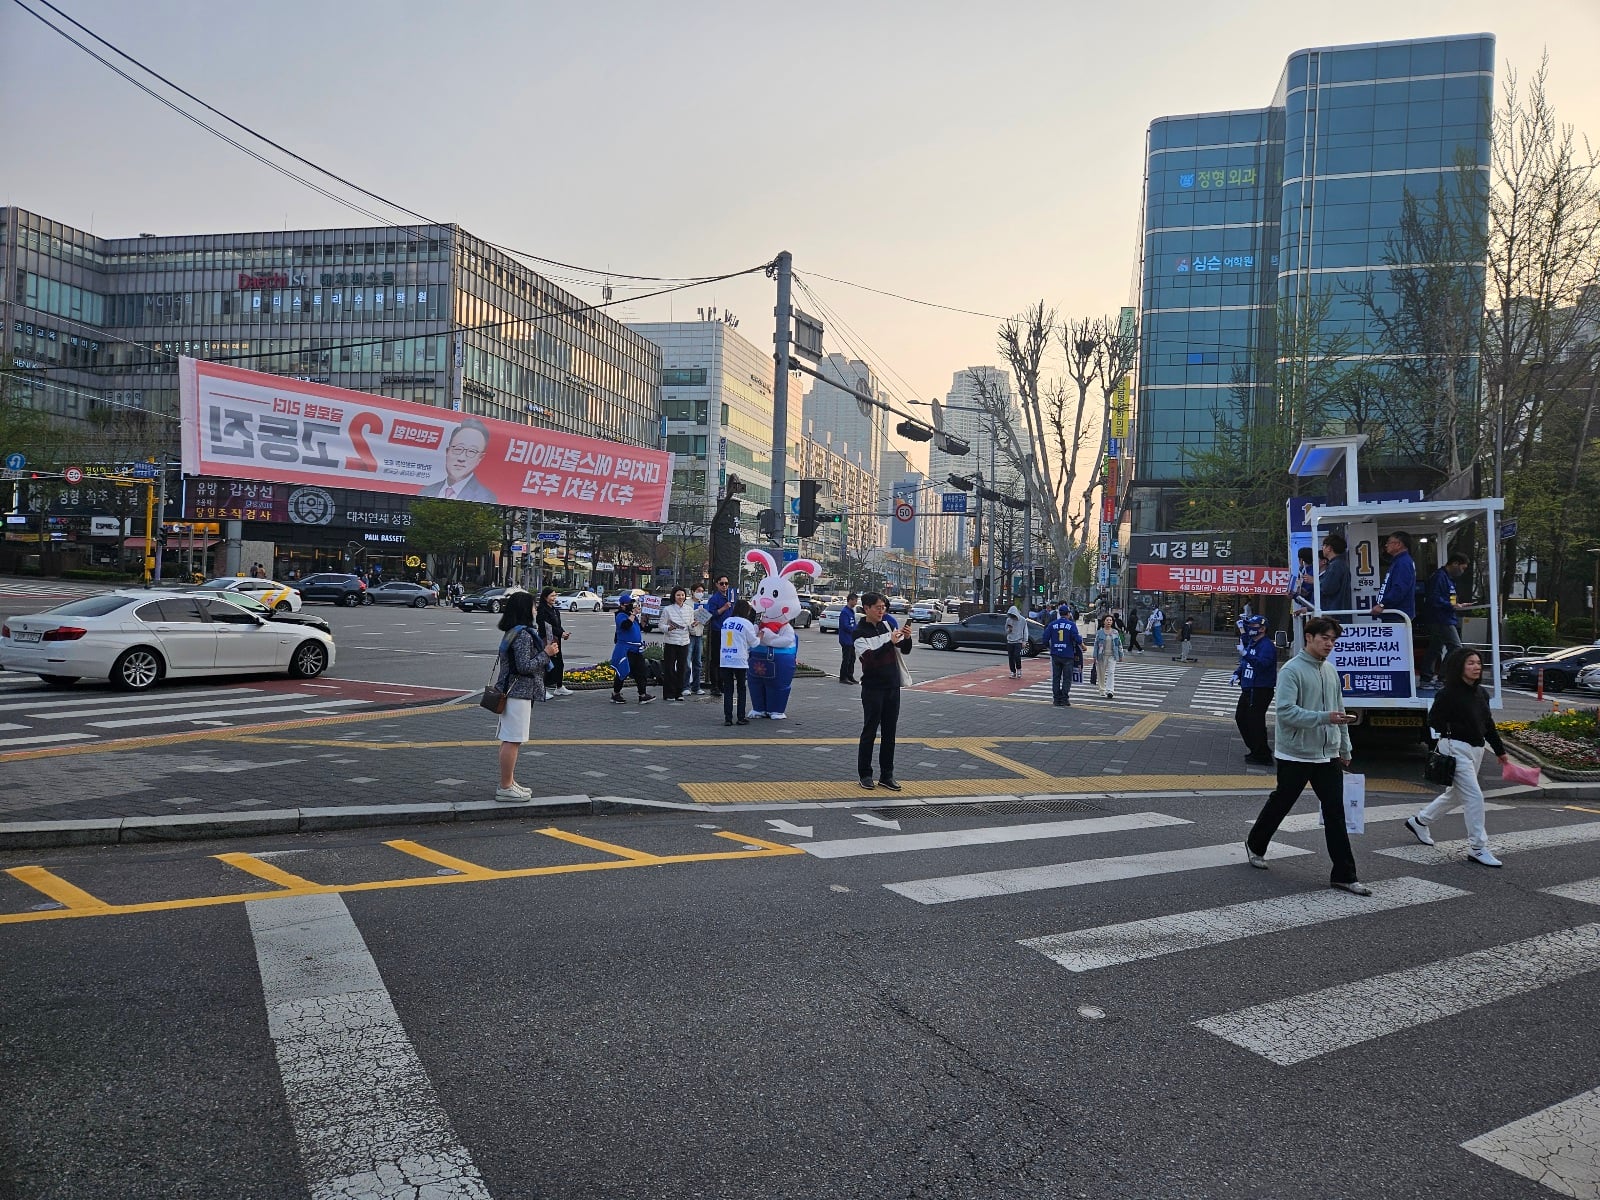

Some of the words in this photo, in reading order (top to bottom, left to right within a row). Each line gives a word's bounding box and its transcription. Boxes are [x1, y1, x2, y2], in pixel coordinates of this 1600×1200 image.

[69, 471, 79, 480] 50
[197, 482, 217, 495] 유방
[230, 483, 273, 499] 갑상선
[346, 511, 389, 523] 대치연세
[900, 508, 910, 517] 50
[364, 533, 379, 541] PAUL
[1356, 541, 1374, 577] 1
[1168, 567, 1217, 584] 국민이
[1222, 570, 1255, 585] 답인
[1058, 630, 1064, 642] 1
[1340, 626, 1393, 637] 선거기간중
[1334, 641, 1399, 652] 양보해주셔서
[1342, 673, 1352, 690] 1
[1354, 679, 1392, 691] 박경미
